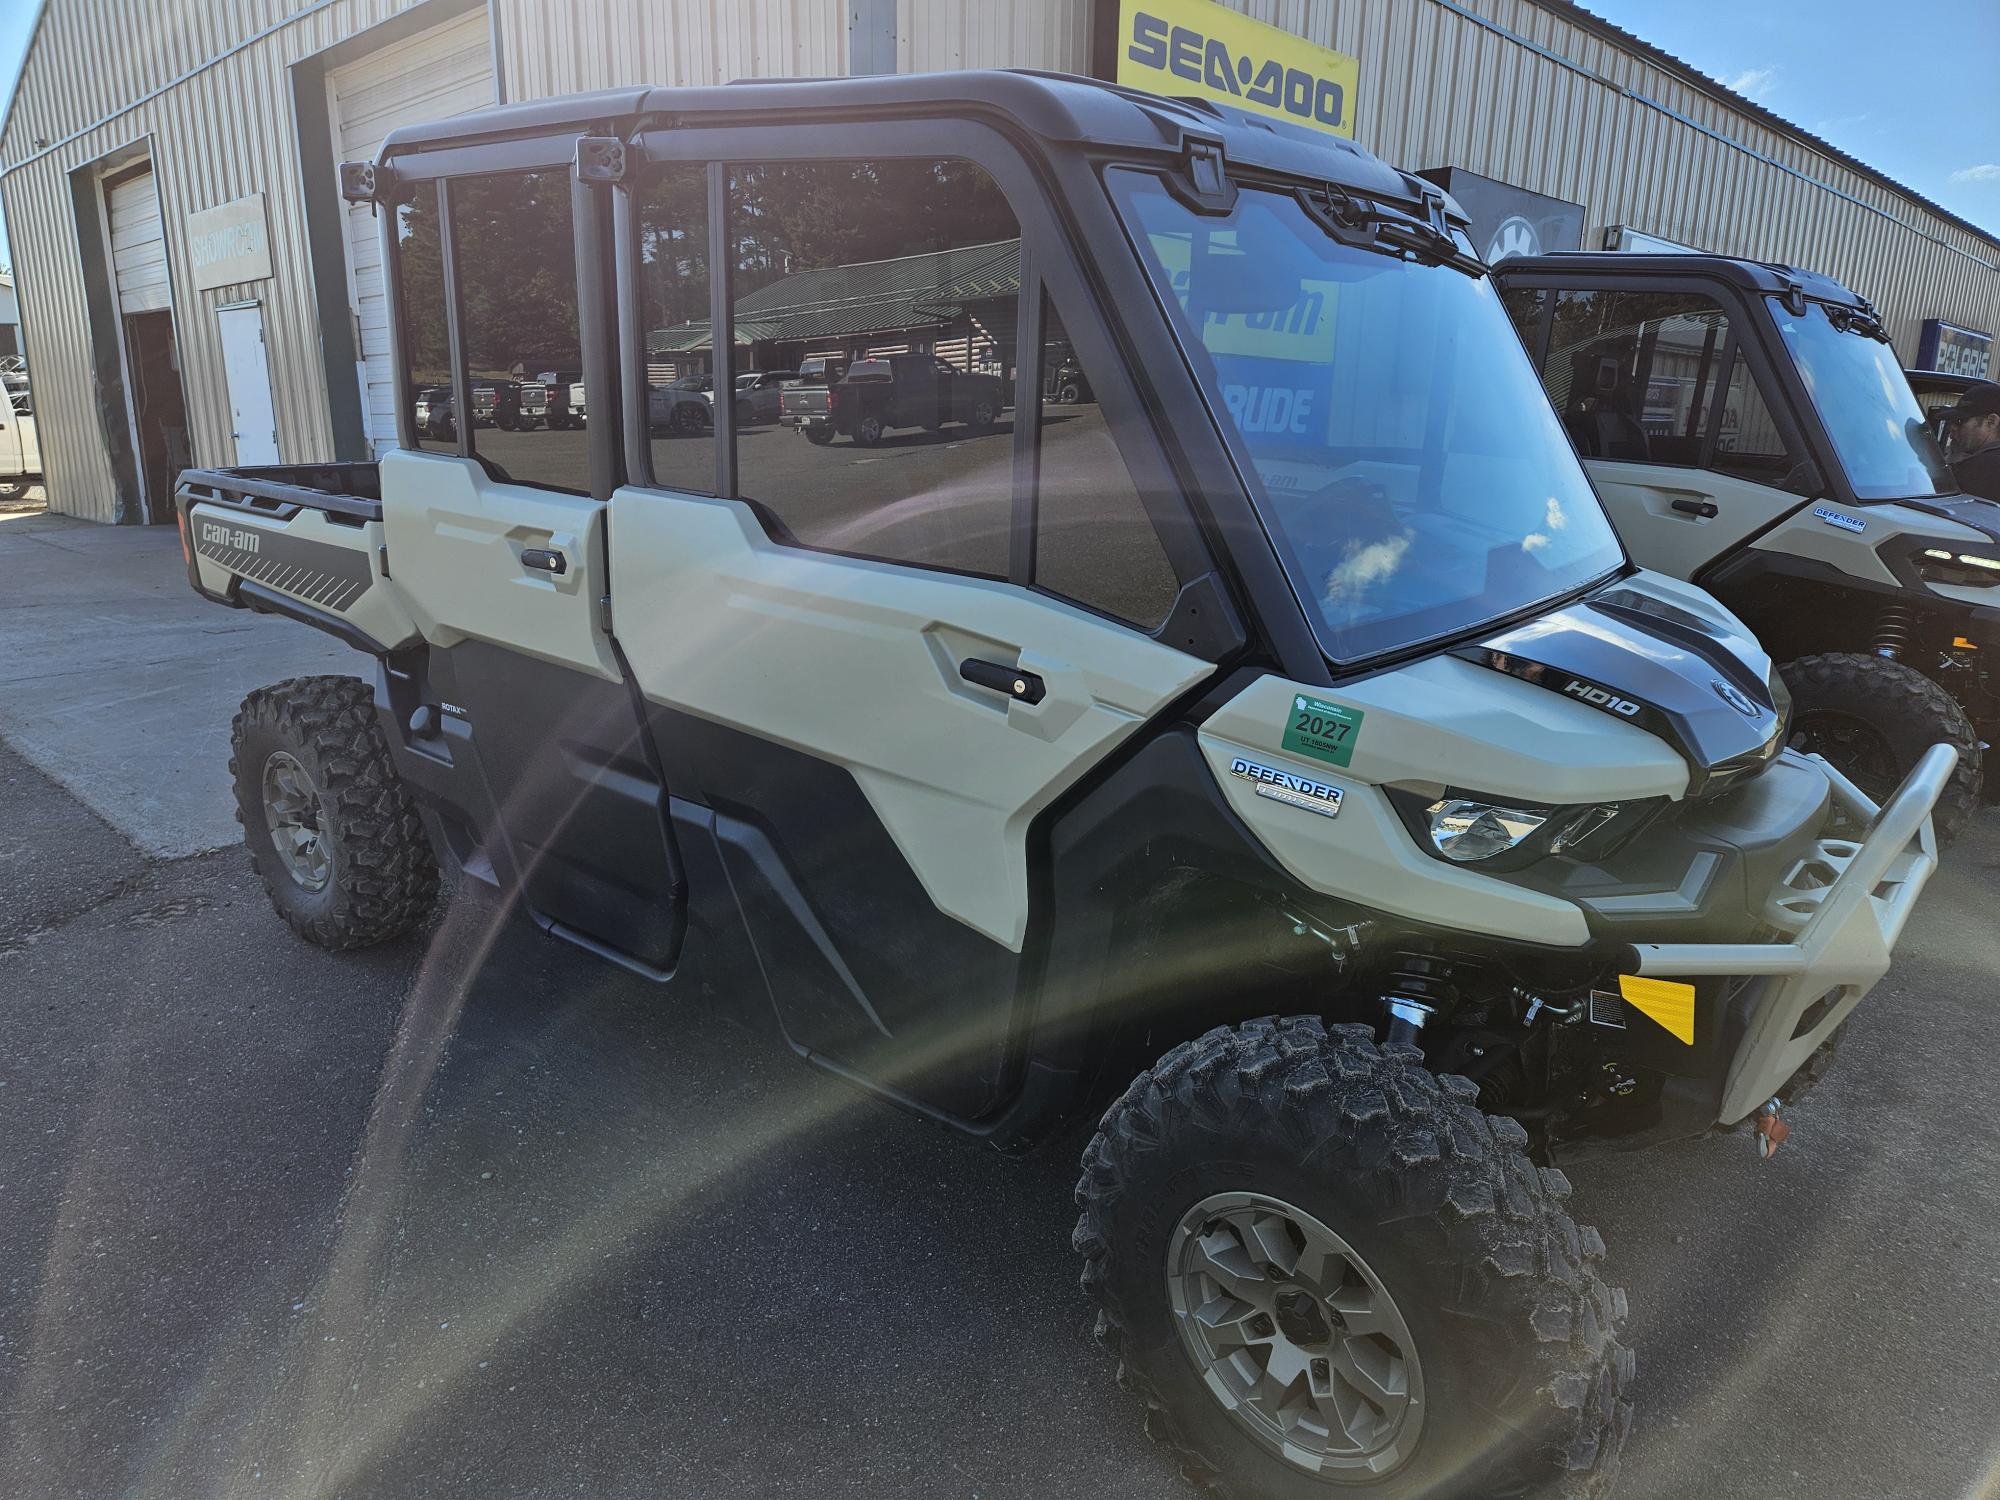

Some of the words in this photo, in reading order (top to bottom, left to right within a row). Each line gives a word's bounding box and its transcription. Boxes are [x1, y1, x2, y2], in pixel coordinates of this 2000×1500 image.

[1936, 341, 1990, 379] POLARIS
[1815, 507, 1865, 527] DEFENDER
[1313, 701, 1343, 714] Wisconsin
[1564, 680, 1641, 716] HD10
[1296, 713, 1352, 742] 2027
[1234, 760, 1340, 804] DEFENDER
